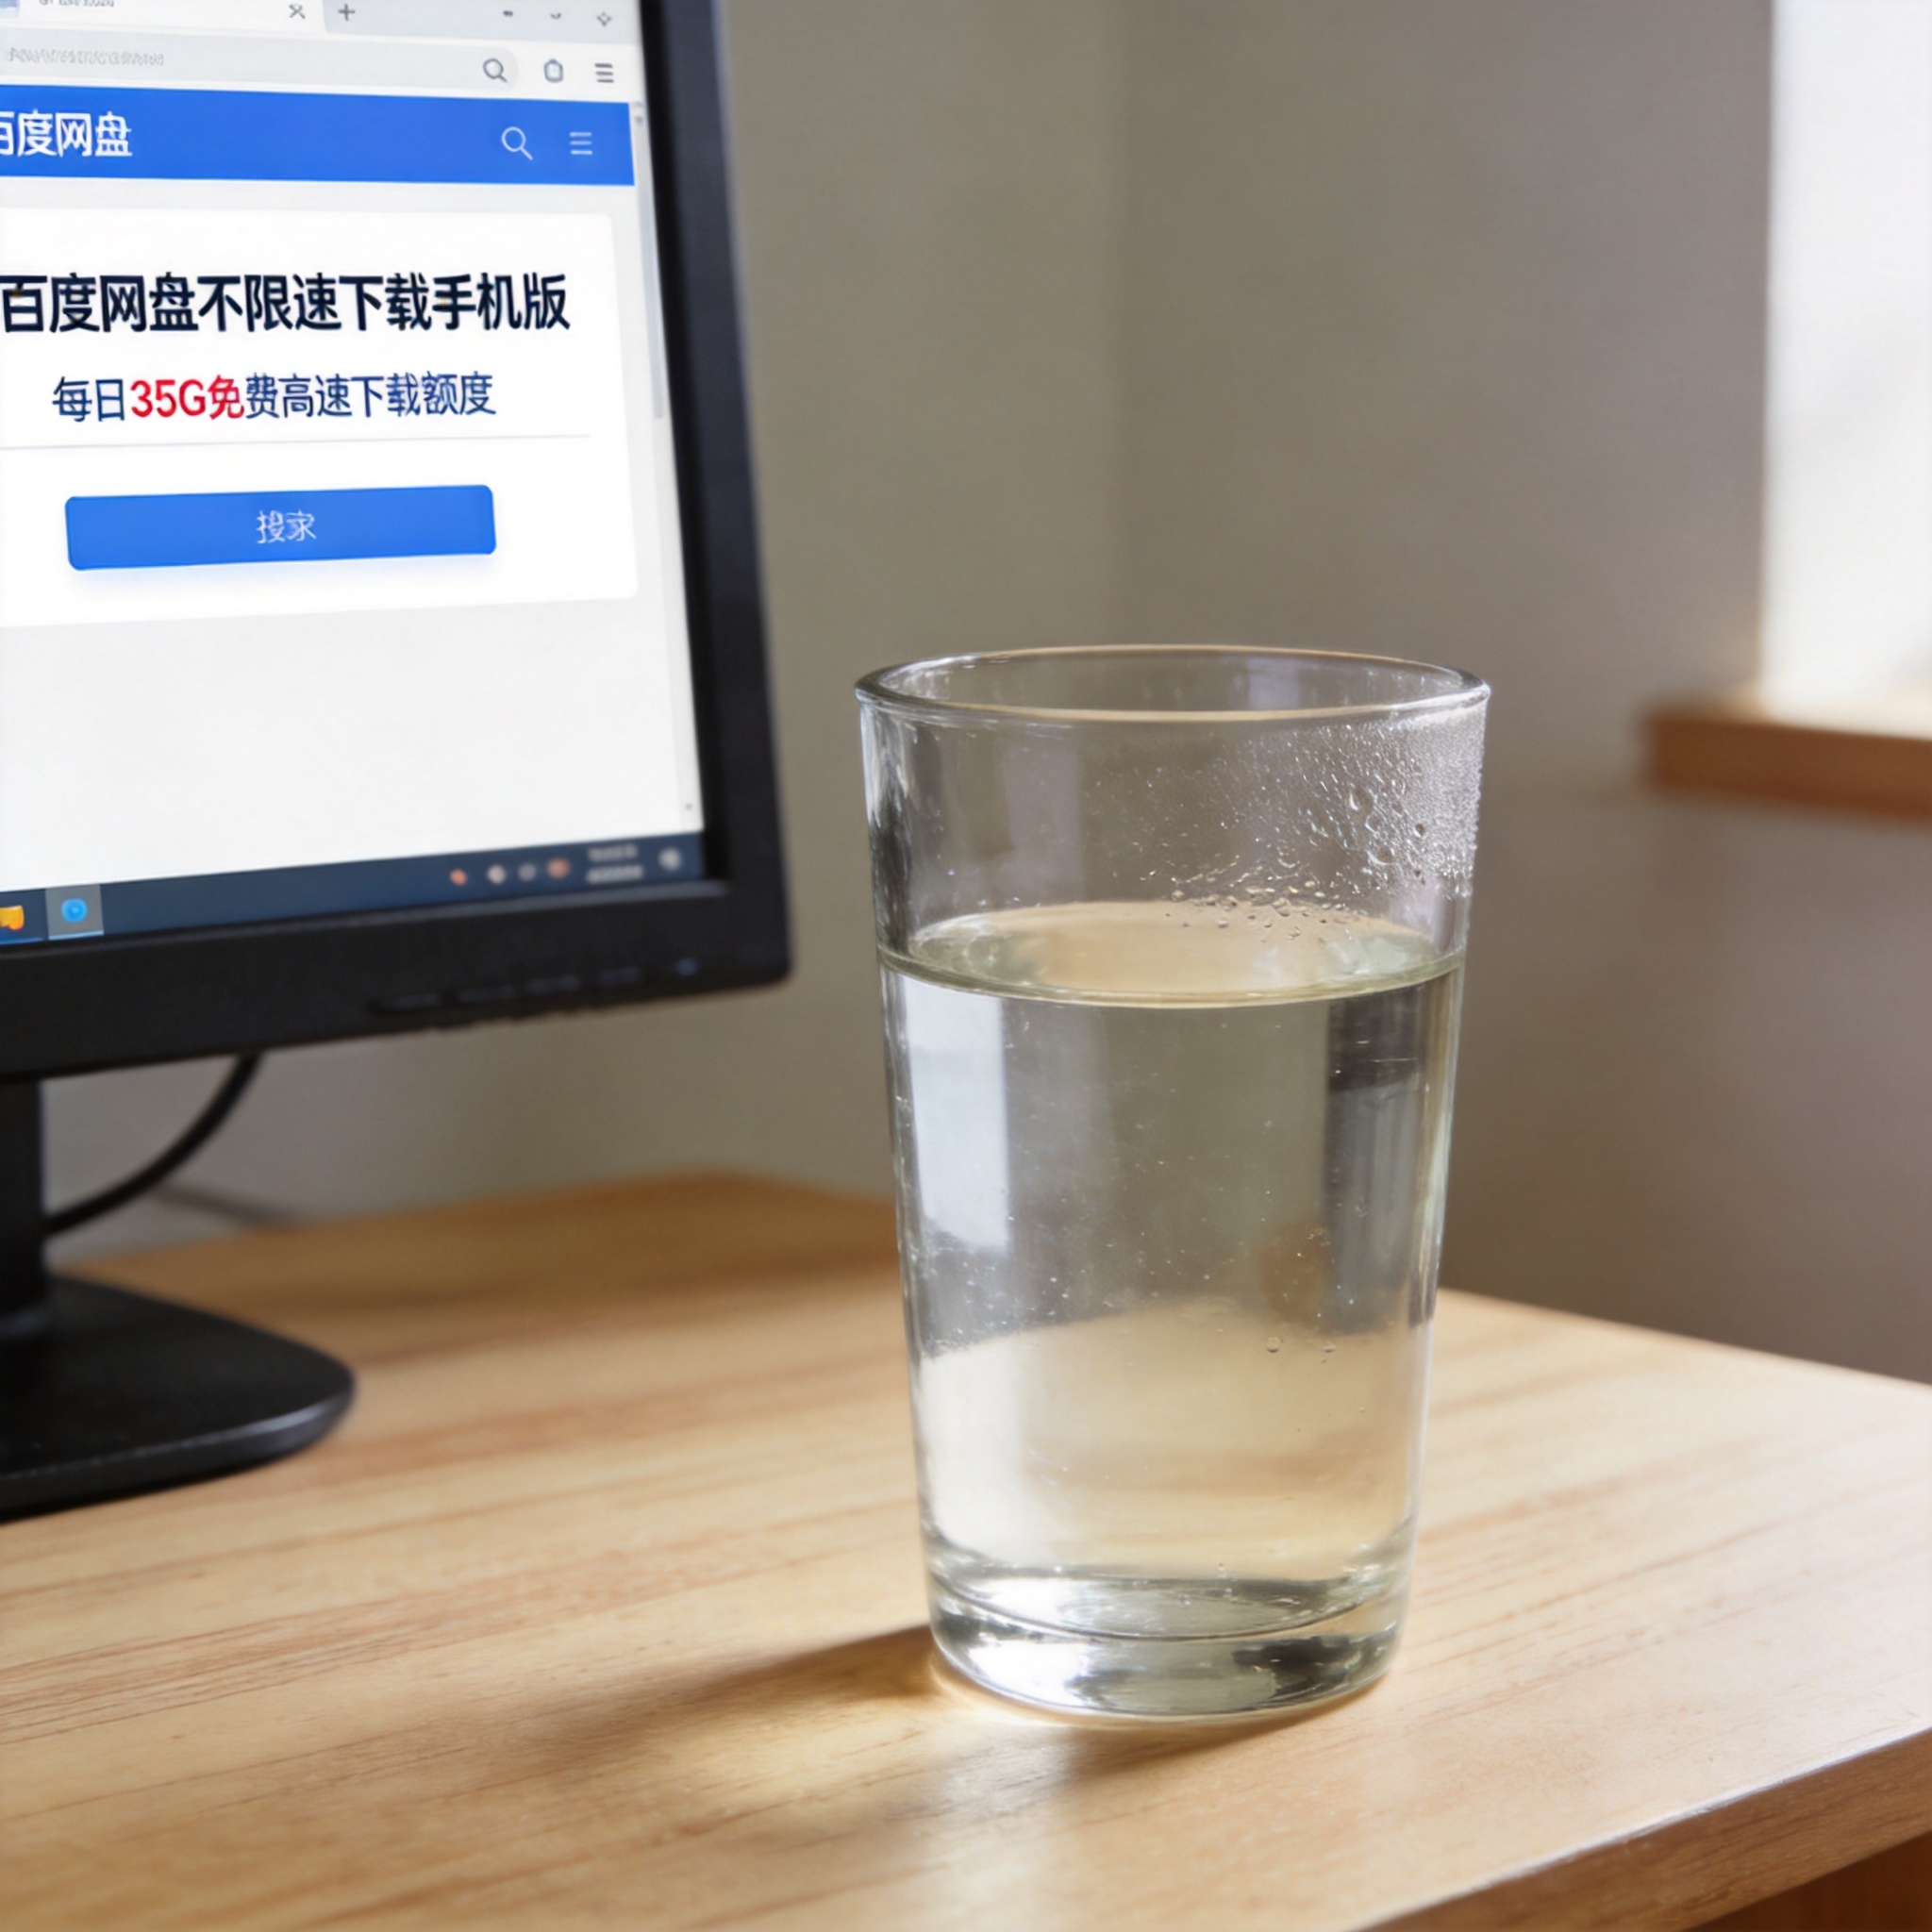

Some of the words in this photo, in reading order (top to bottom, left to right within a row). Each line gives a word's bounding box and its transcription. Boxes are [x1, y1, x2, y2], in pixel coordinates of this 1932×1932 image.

[0, 271, 571, 333] 百度网盘不限速下载手机版
[52, 371, 497, 423] 每日35G免费高速下载额度
